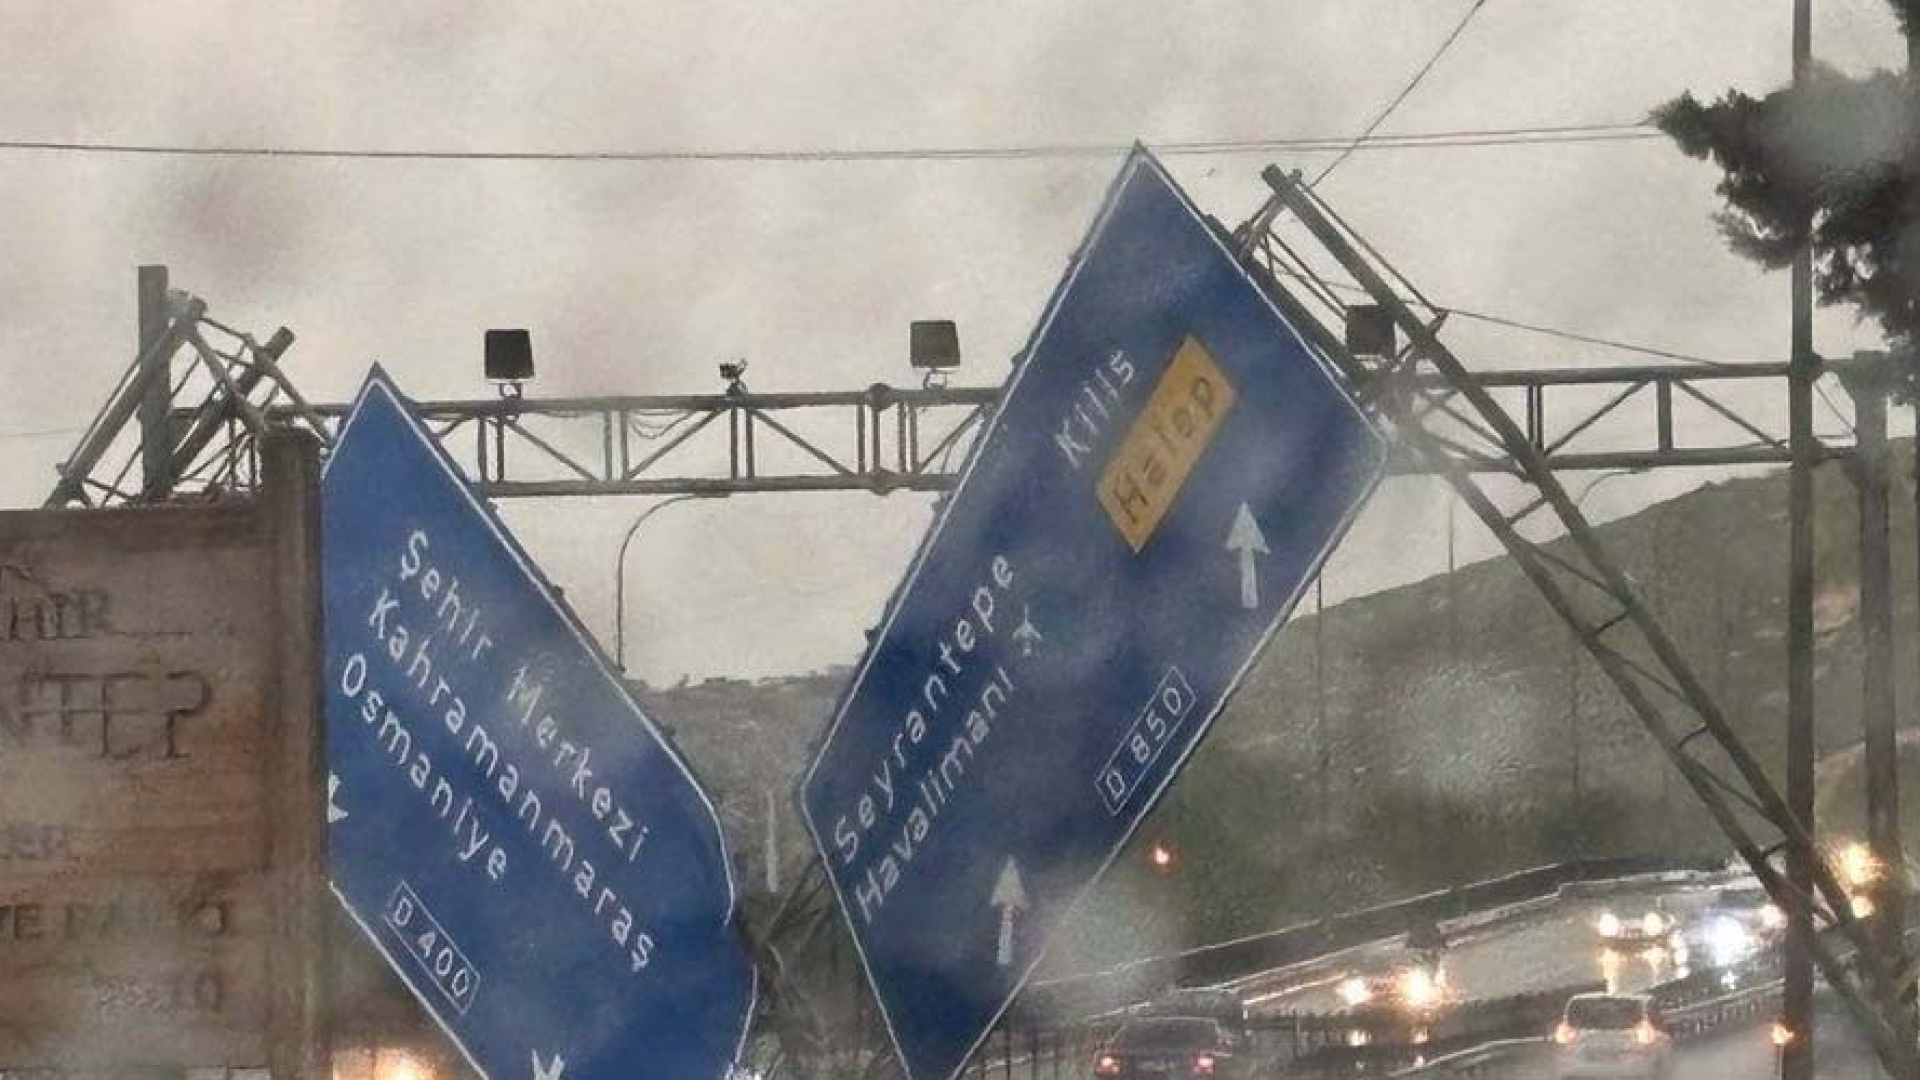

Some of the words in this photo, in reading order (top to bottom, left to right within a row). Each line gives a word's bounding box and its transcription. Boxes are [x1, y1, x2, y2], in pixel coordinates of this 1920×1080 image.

[1054, 350, 1135, 468] Kilis
[1113, 377, 1214, 524] Halep
[341, 652, 508, 880] Osmaniye
[368, 589, 654, 973] Kahramanmaraş
[401, 530, 493, 661] Şehir
[507, 666, 649, 862] Merkezi
[834, 555, 1013, 863] Seyrantepe
[1106, 769, 1125, 800] D
[1130, 687, 1182, 763] 850
[394, 897, 413, 927] D
[416, 932, 470, 997] 400
